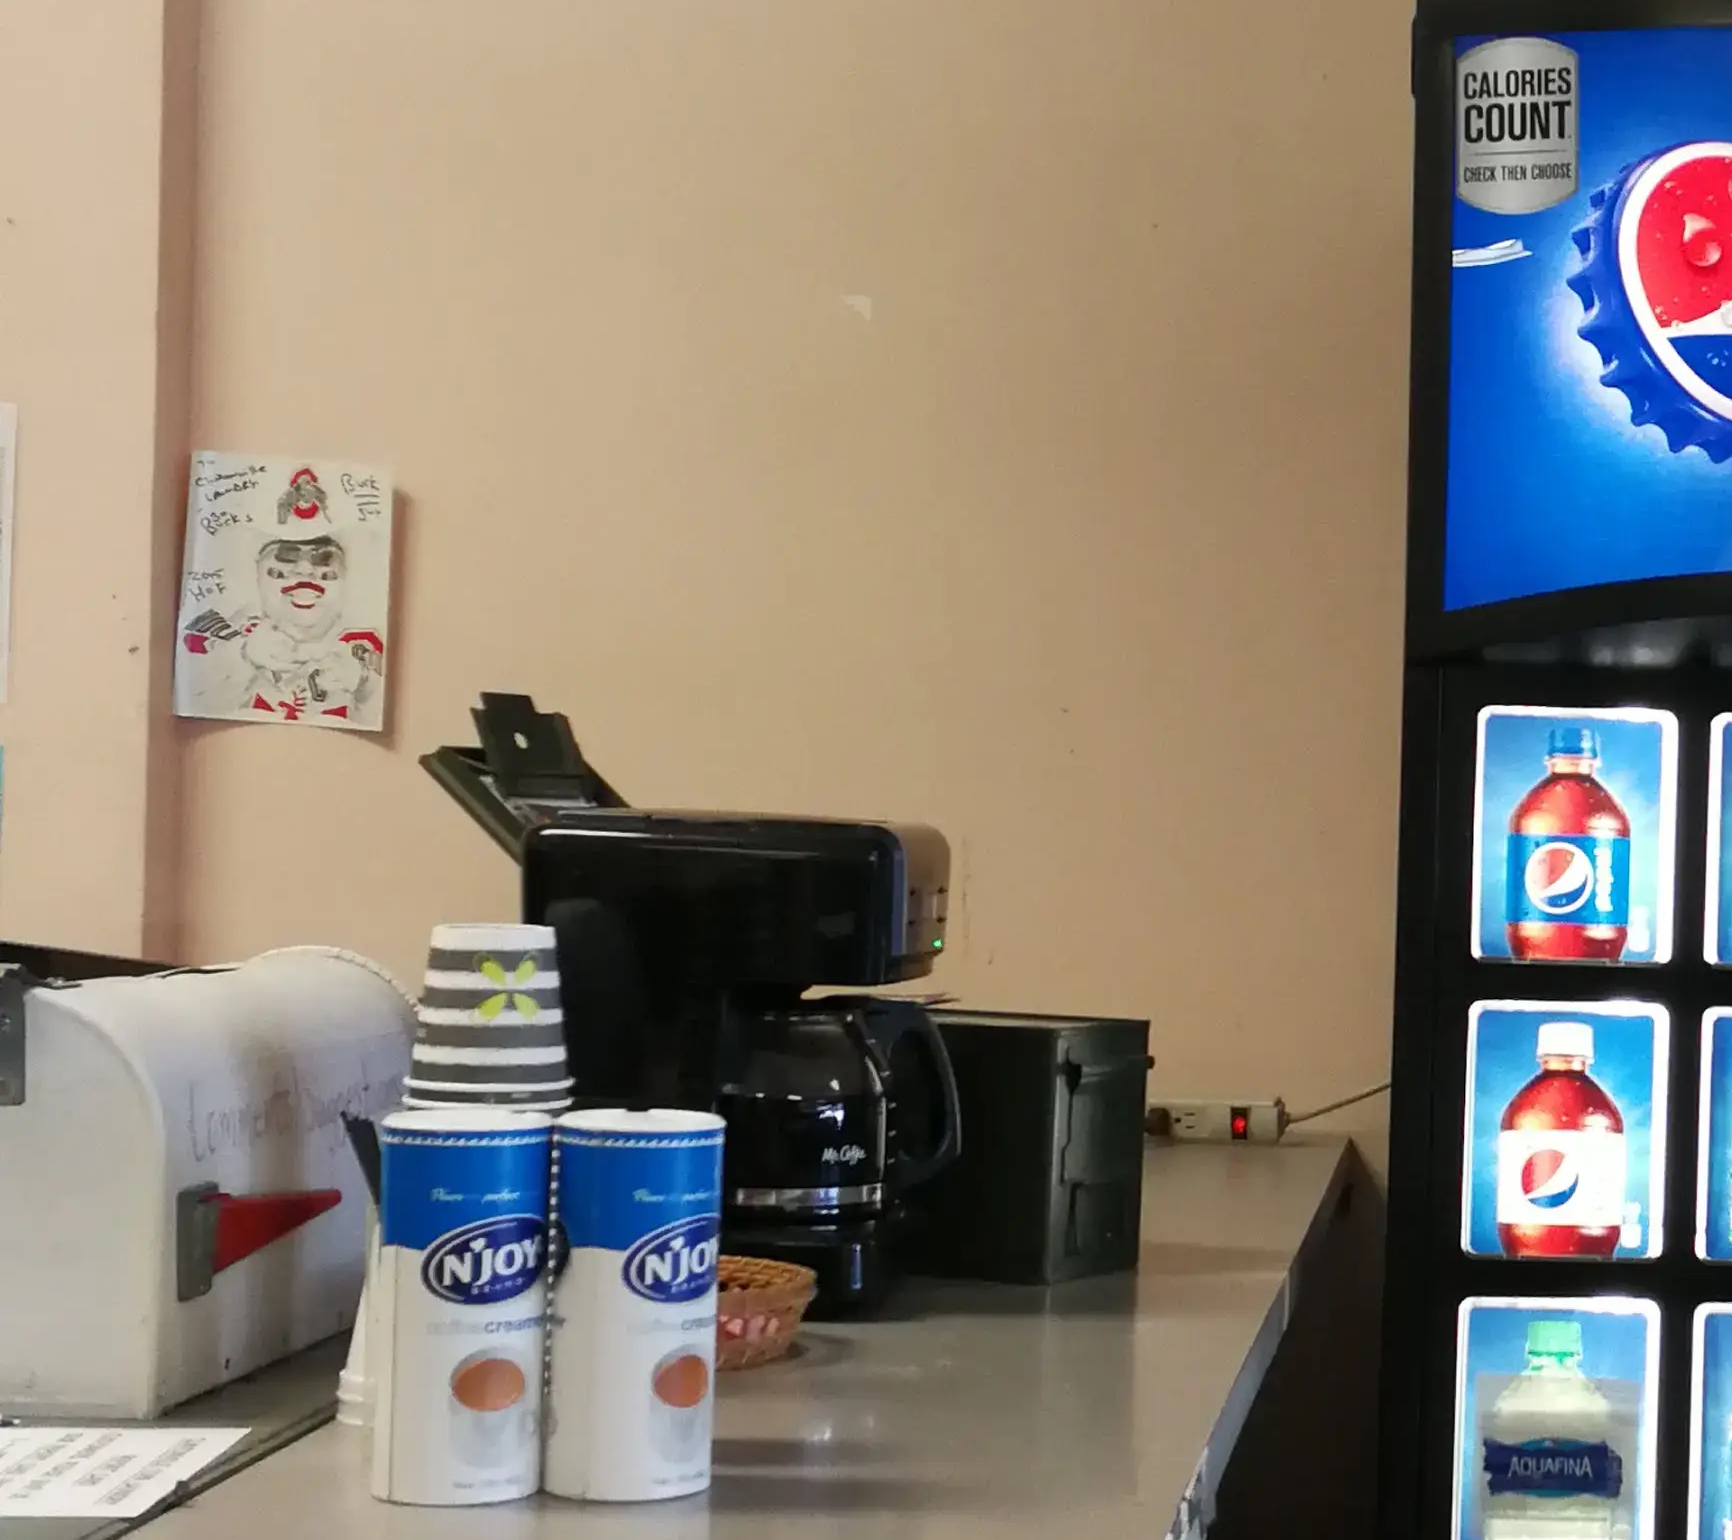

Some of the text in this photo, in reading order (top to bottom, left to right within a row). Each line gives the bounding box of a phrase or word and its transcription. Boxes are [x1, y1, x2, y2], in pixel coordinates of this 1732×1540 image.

[1464, 67, 1572, 99] CALORIES
[1464, 100, 1572, 143] COUNT
[1464, 162, 1573, 183] CHECK THEN CHOOSE
[1506, 1455, 1594, 1480] AQUAFINA
